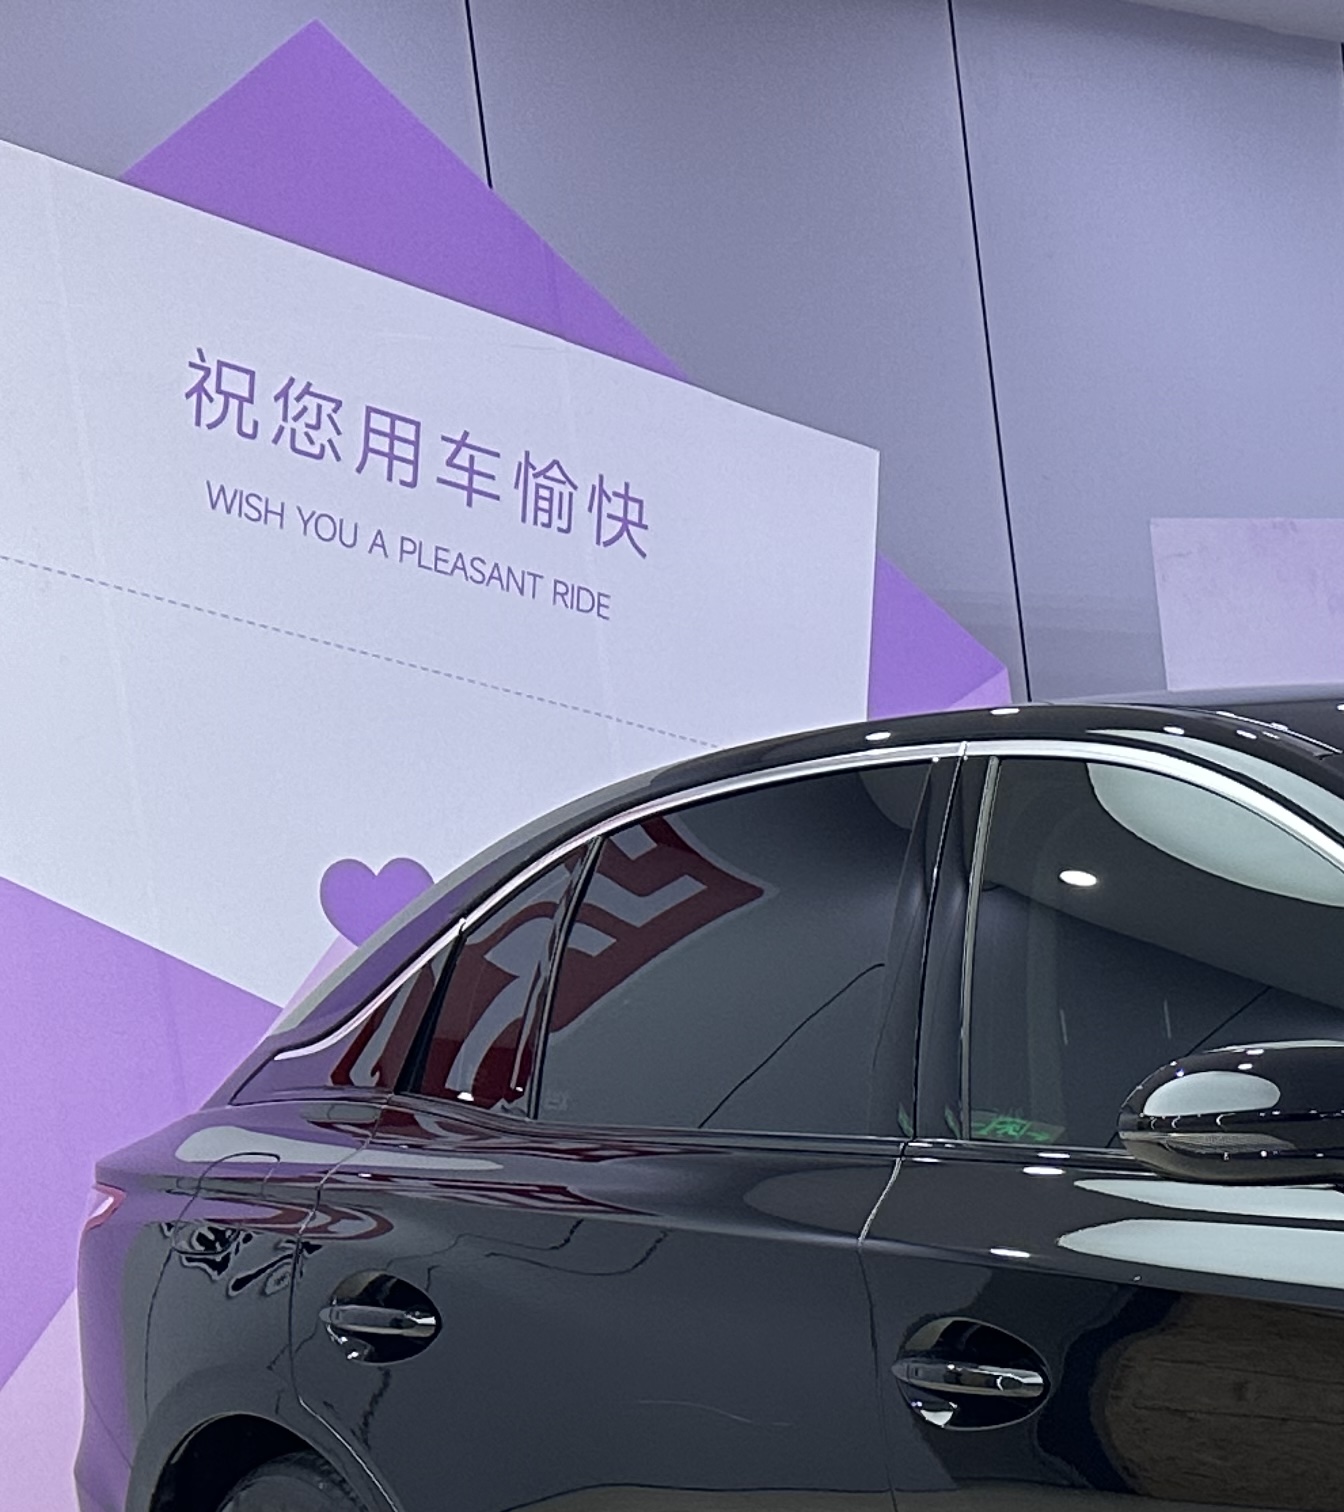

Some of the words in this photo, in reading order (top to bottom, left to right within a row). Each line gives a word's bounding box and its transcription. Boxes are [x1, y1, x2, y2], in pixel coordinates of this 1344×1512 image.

[184, 346, 650, 560] 祝您用车愉快
[206, 479, 285, 529] WISH
[296, 506, 359, 549] YOU
[367, 528, 389, 559] A
[399, 536, 545, 600] PLEASANT
[552, 579, 612, 621] RIDE
